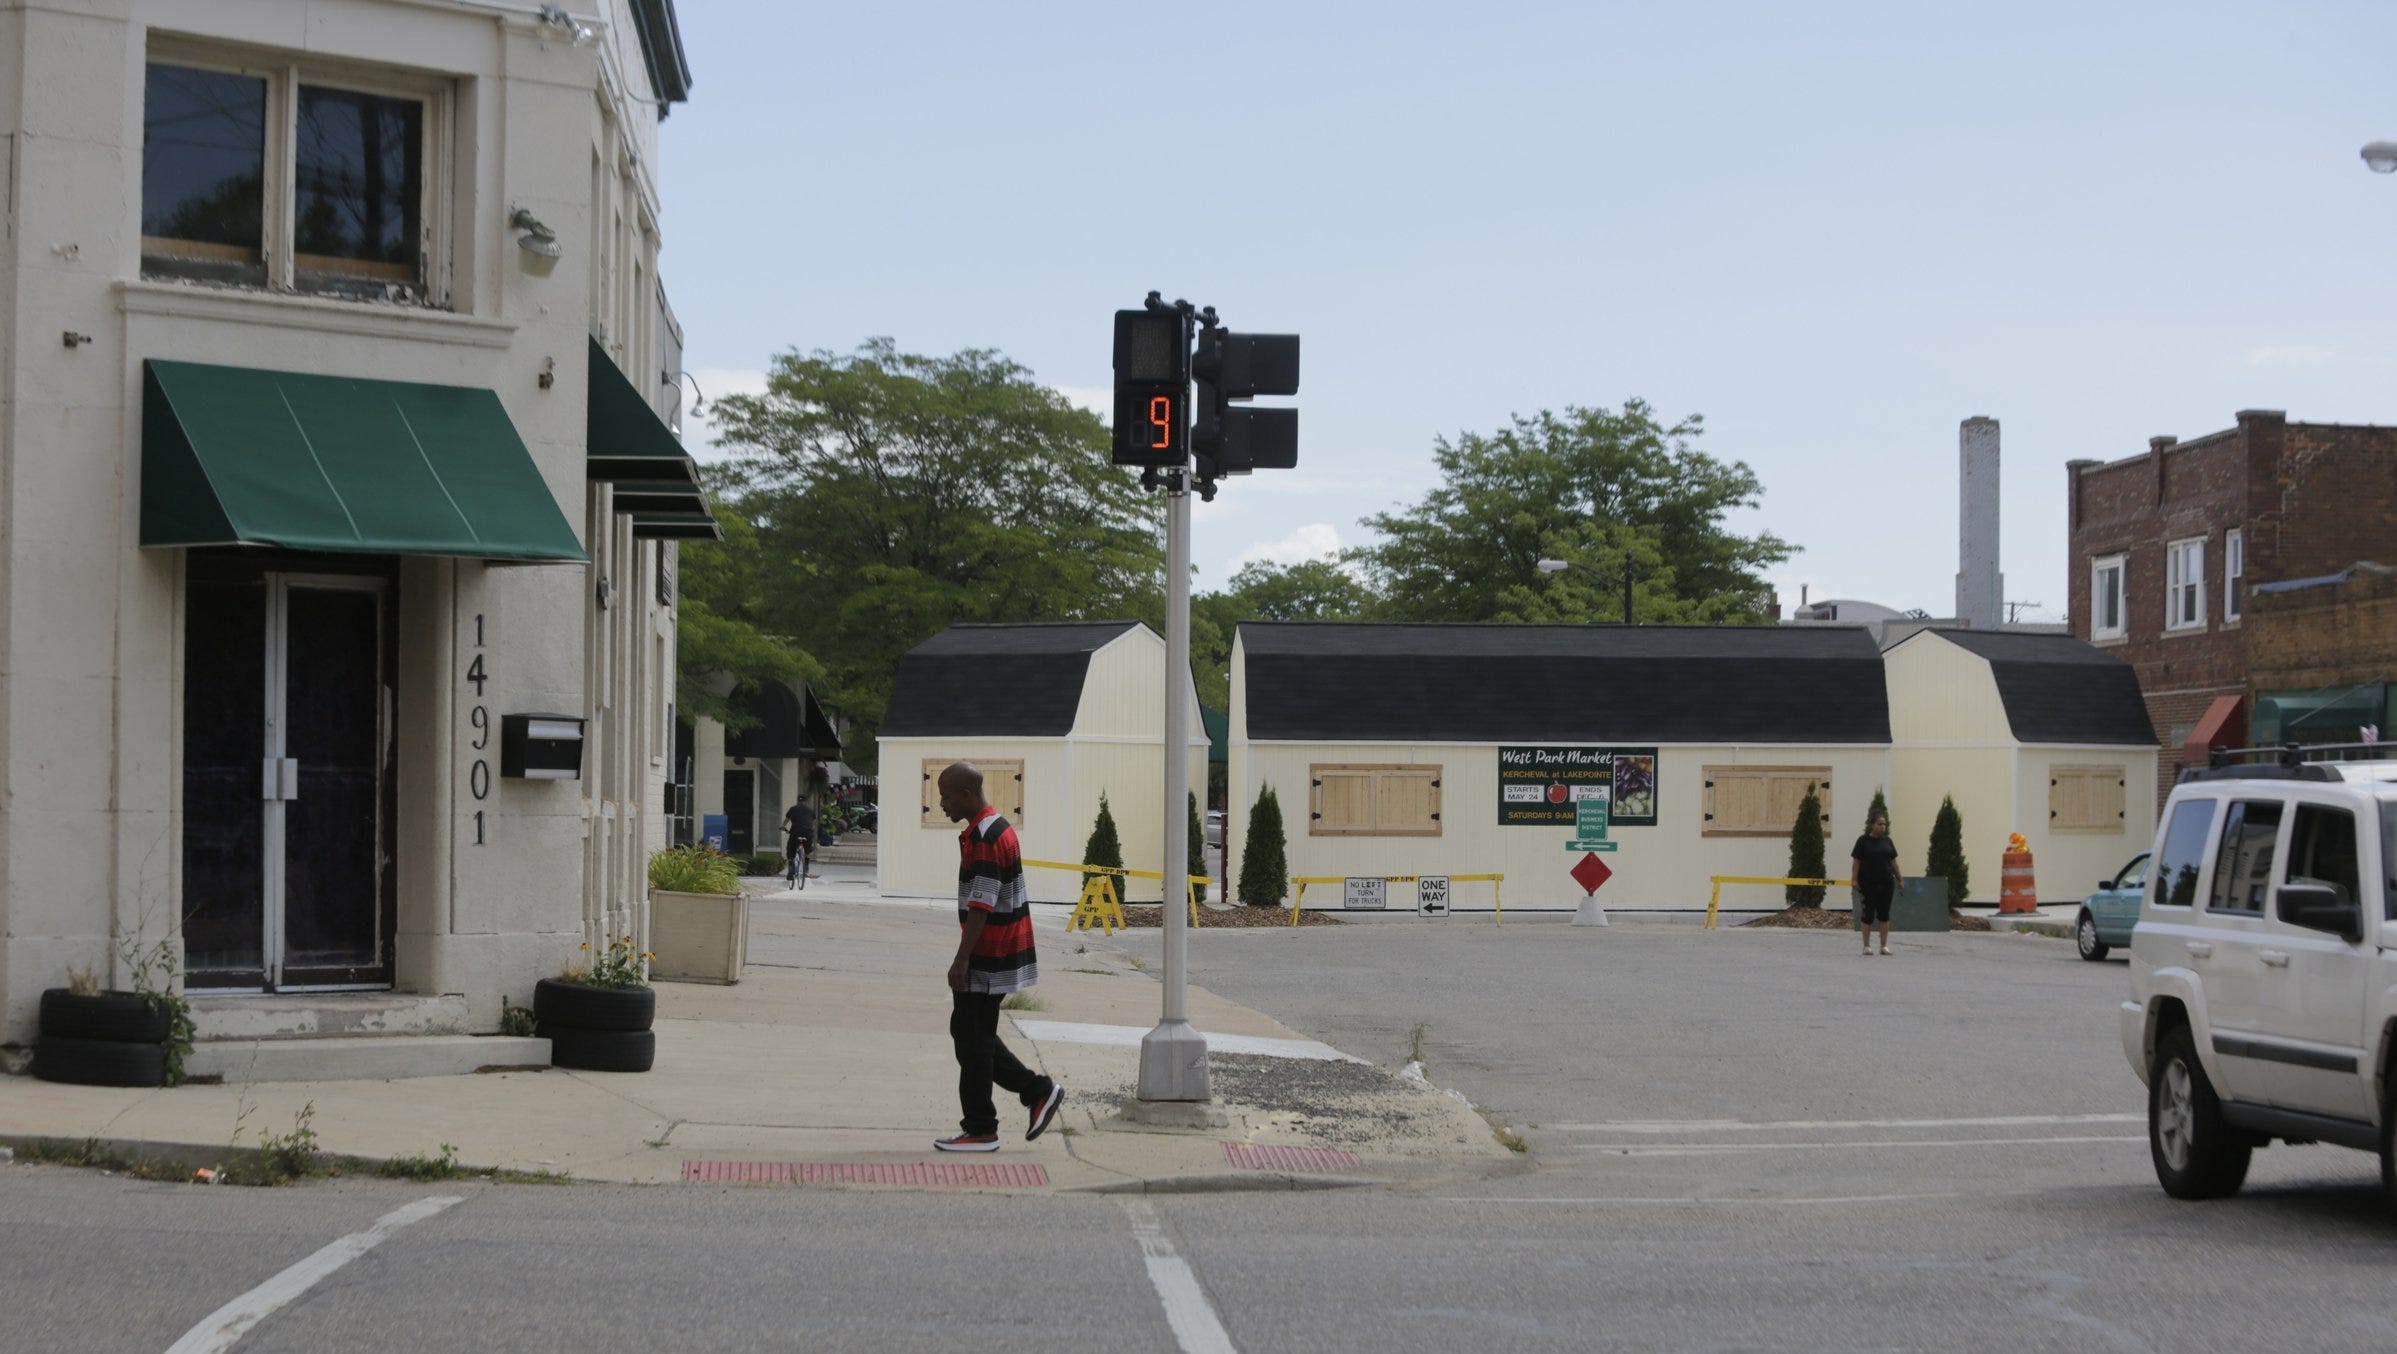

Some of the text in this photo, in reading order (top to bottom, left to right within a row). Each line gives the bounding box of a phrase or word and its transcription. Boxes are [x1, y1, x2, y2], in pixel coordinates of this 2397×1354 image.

[1150, 396, 1170, 449] 9
[466, 613, 489, 847] 14901
[1502, 749, 1612, 765] West Park Market
[1563, 771, 1612, 779] LAKEPOINTE
[1508, 811, 1552, 819] SATURDAYS
[1421, 880, 1446, 890] ONE
[1421, 891, 1446, 901] WAY
